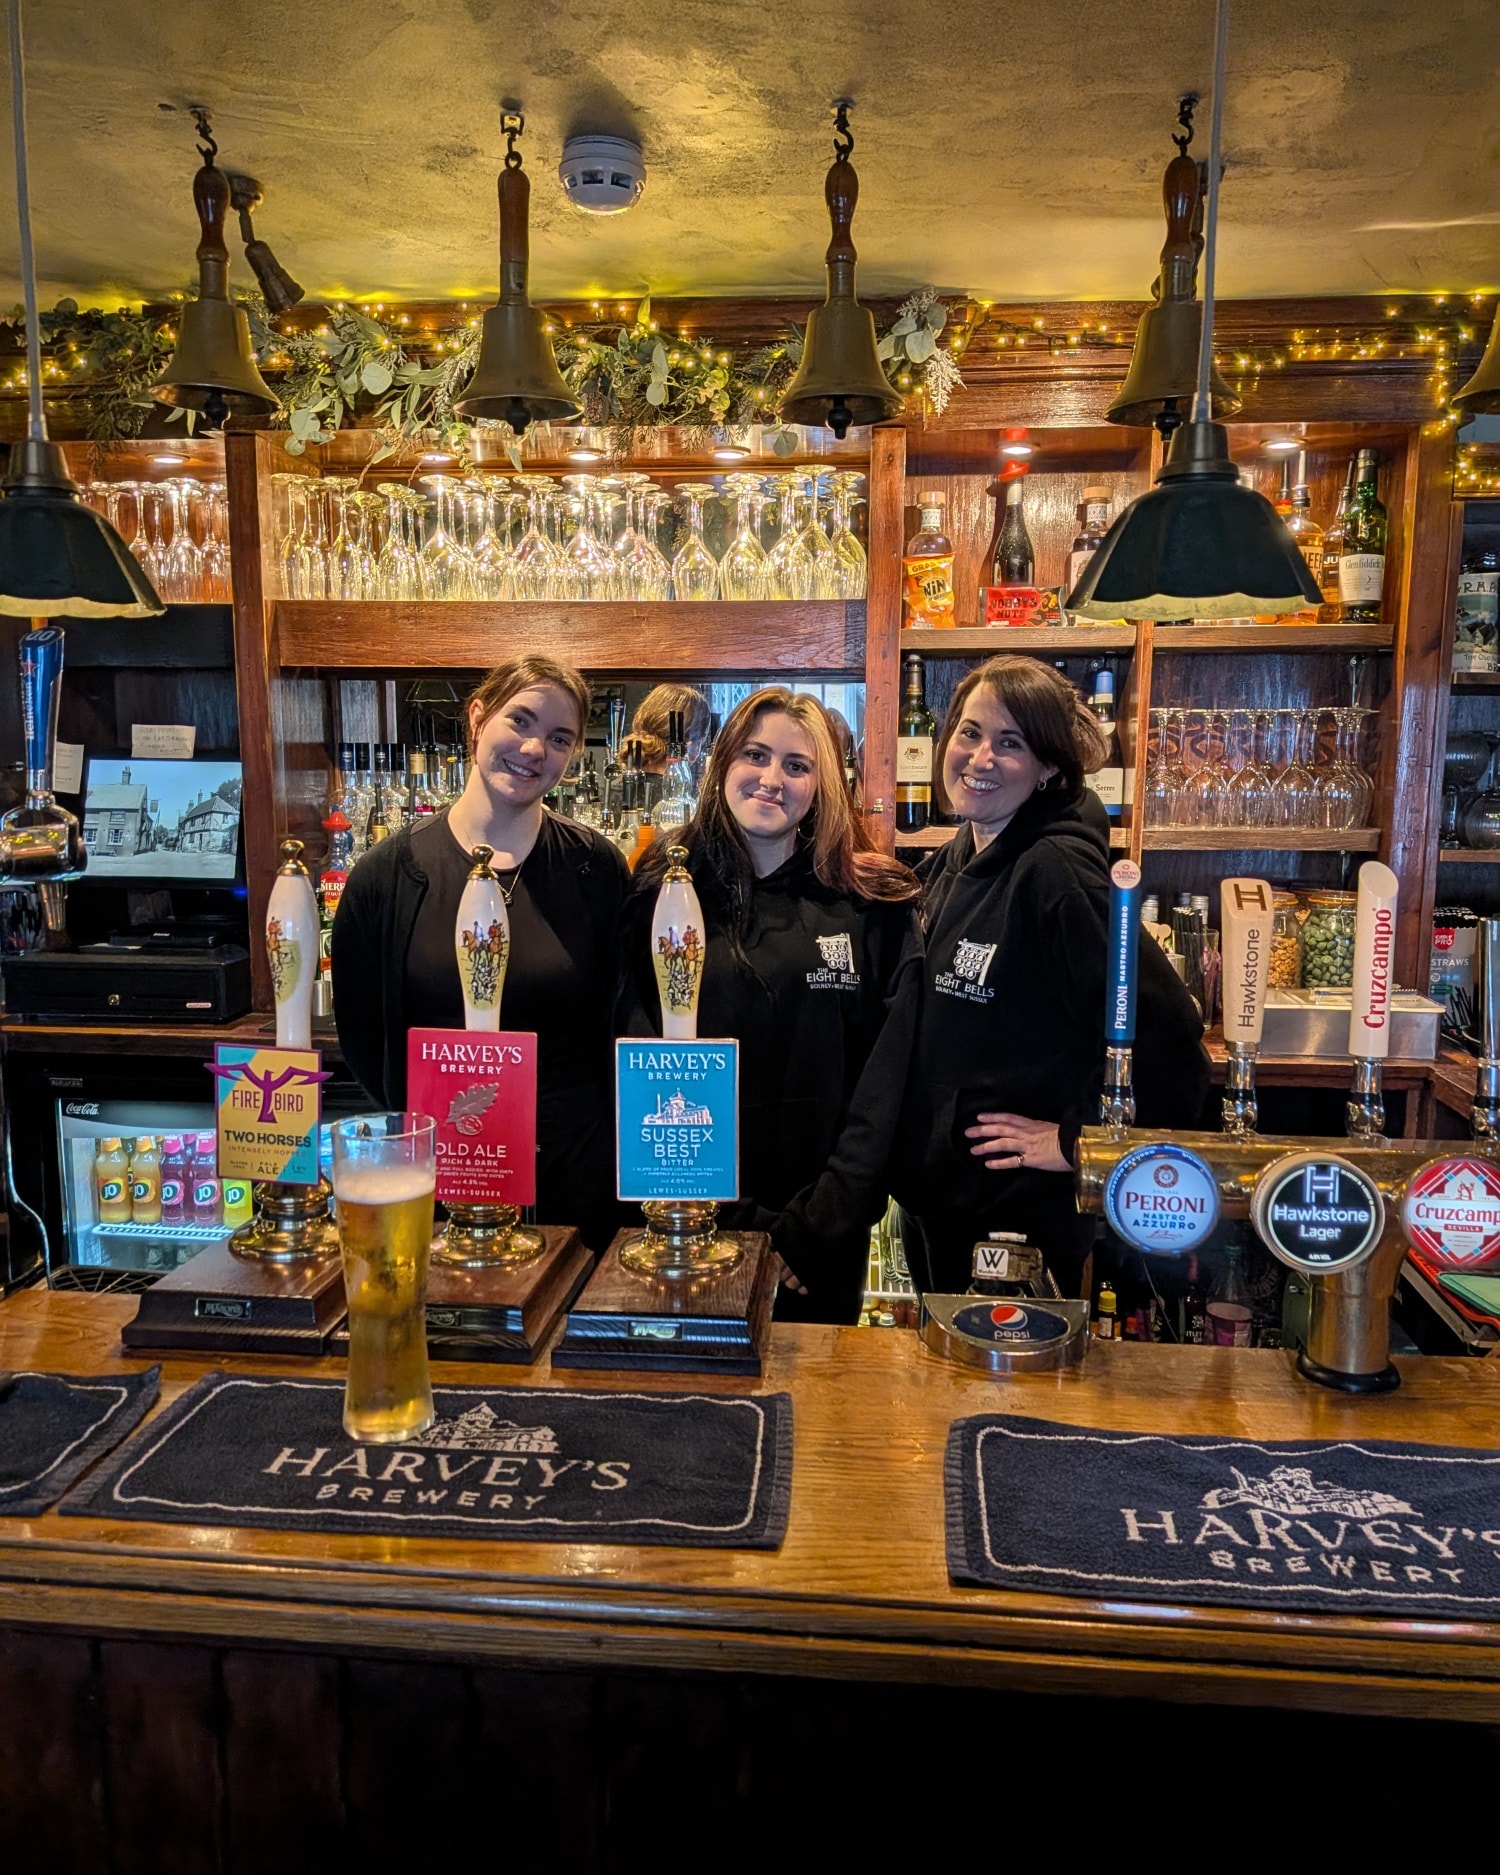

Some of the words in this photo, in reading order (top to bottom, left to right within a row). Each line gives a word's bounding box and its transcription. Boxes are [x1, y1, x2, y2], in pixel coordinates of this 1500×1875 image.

[996, 610, 1026, 618] NUTS
[320, 879, 346, 891] SIERR
[1120, 906, 1128, 946] AZZURRO
[1361, 908, 1394, 1029] Cruzcampo
[1430, 958, 1469, 966] STRAWS
[806, 972, 838, 982] EIGHT
[1237, 928, 1261, 1028] Hawkstone
[935, 974, 962, 990] EIGHT
[964, 982, 995, 998] BELLS
[1114, 984, 1128, 1030] PERONI
[422, 1042, 522, 1064] HARVEY'S
[628, 1052, 726, 1070] HARVEY'S
[440, 1064, 502, 1074] BREWERY
[648, 1072, 707, 1080] BREWERY
[232, 1090, 260, 1109] FIRE
[274, 1093, 304, 1112] BIRD
[224, 1130, 256, 1142] TWO
[256, 1132, 312, 1148] HORSES
[641, 1128, 714, 1142] SUSSEX
[474, 1144, 506, 1158] ALE
[654, 1144, 702, 1158] BEST
[257, 1166, 279, 1175] ALE
[466, 1158, 471, 1166] &
[1124, 1192, 1207, 1214] PERONI
[1142, 1213, 1186, 1221] NASTRO
[1274, 1204, 1370, 1222] Hawkstone
[1415, 1202, 1500, 1226] Cruzcamp
[1132, 1219, 1196, 1230] AZZURRO
[1300, 1224, 1341, 1241] Lager
[1448, 1224, 1480, 1232] SEVILLA
[982, 1249, 1005, 1269] W
[994, 1330, 1030, 1340] pepsi
[262, 1447, 630, 1491] HARVEY'S
[315, 1482, 546, 1510] BREWERY
[1208, 1550, 1465, 1584] BREWERY
